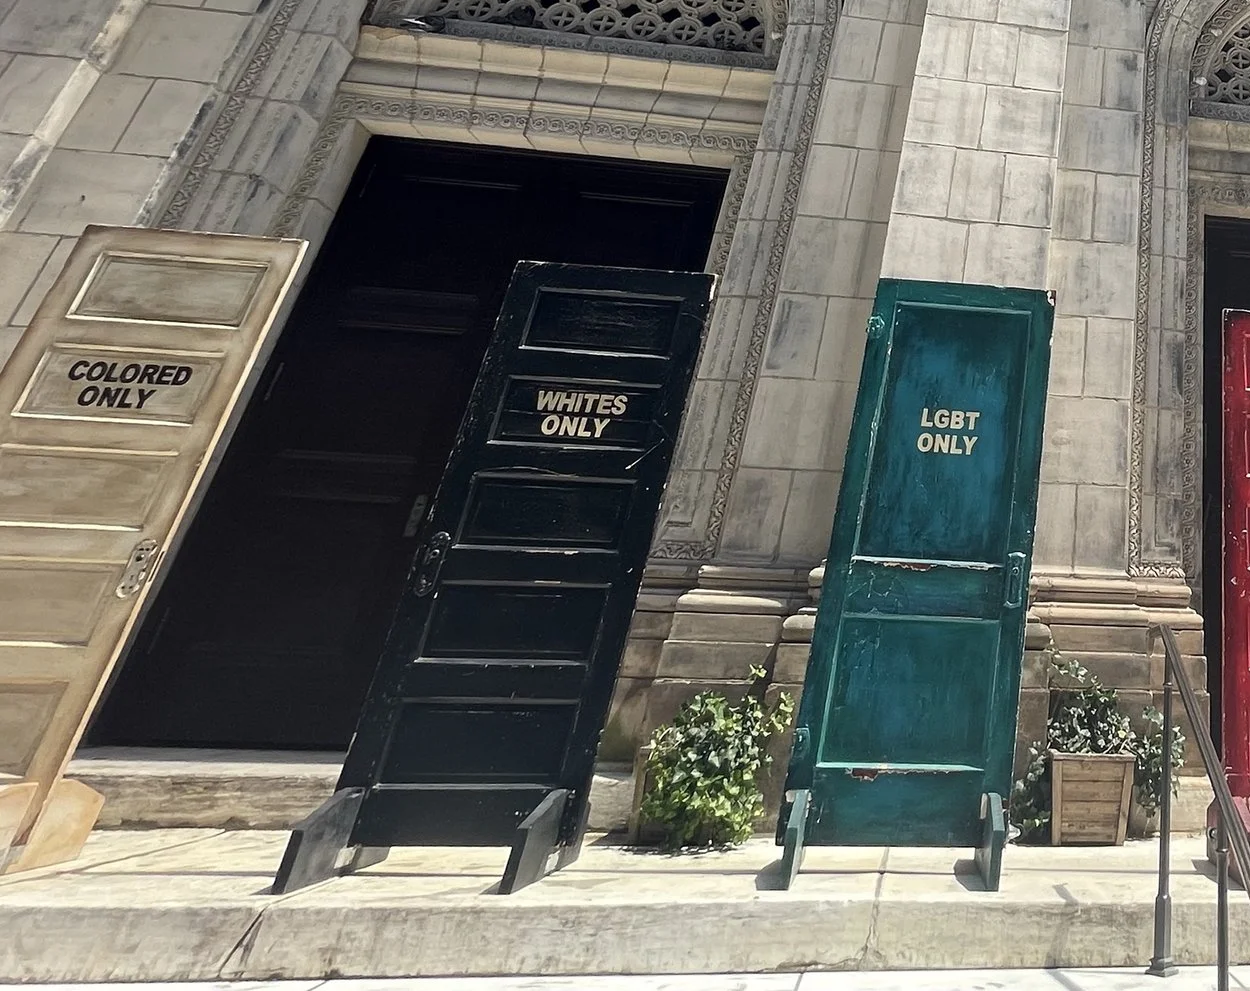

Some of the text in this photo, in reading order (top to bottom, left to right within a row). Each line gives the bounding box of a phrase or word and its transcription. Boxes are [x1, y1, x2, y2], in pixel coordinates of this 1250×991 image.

[67, 360, 194, 386] COLORED
[77, 385, 157, 409] ONLY
[536, 390, 628, 416] WHITES
[540, 414, 611, 438] ONLY
[920, 408, 980, 431] LGBT
[917, 432, 979, 456] ONLY
